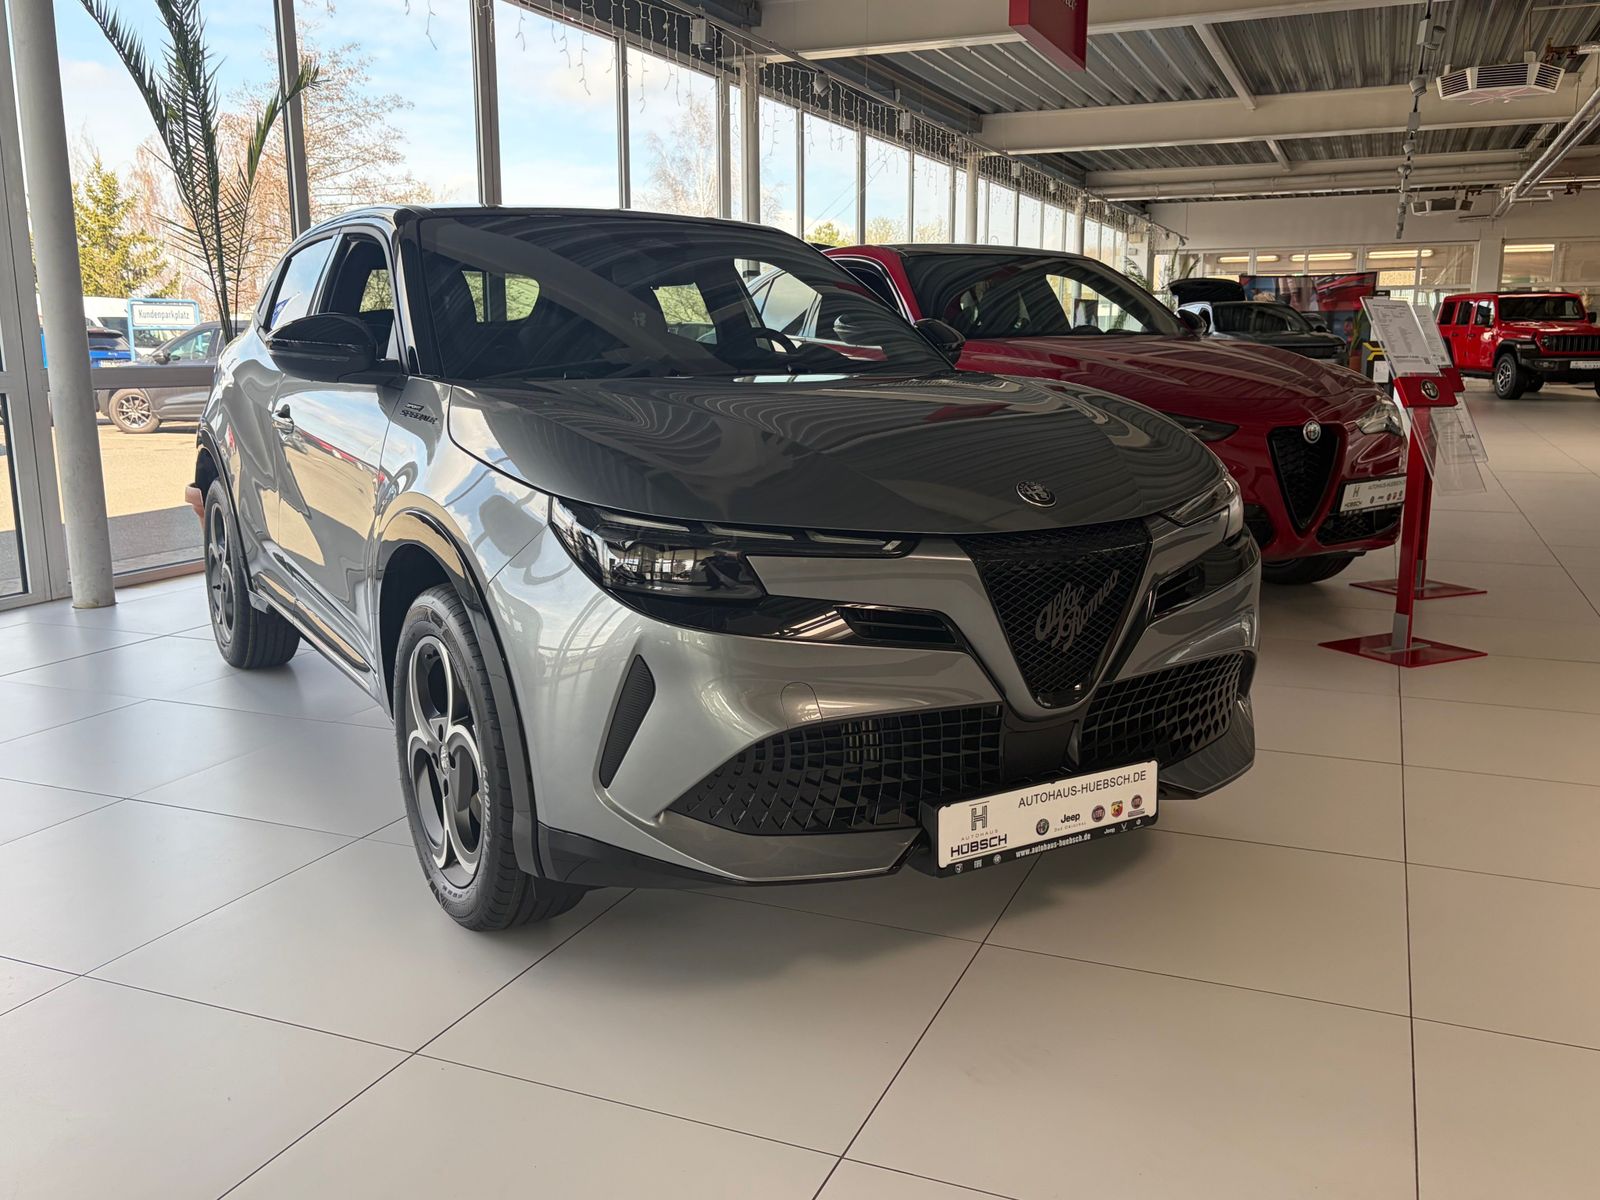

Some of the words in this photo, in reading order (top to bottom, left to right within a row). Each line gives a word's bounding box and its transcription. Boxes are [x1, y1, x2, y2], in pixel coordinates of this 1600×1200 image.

[138, 309, 190, 320] Kundenparkplatz
[1035, 582, 1085, 648] Alfa
[1061, 569, 1120, 651] Romeo
[1017, 770, 1147, 809] AUTOHAUS-HUEBSCH.DE
[1060, 812, 1081, 824] Jeep
[950, 833, 1008, 858] HÜBSCH
[961, 829, 999, 841] AUTOHAUS
[1015, 832, 1092, 858] www.autohaus-huebsch.de
